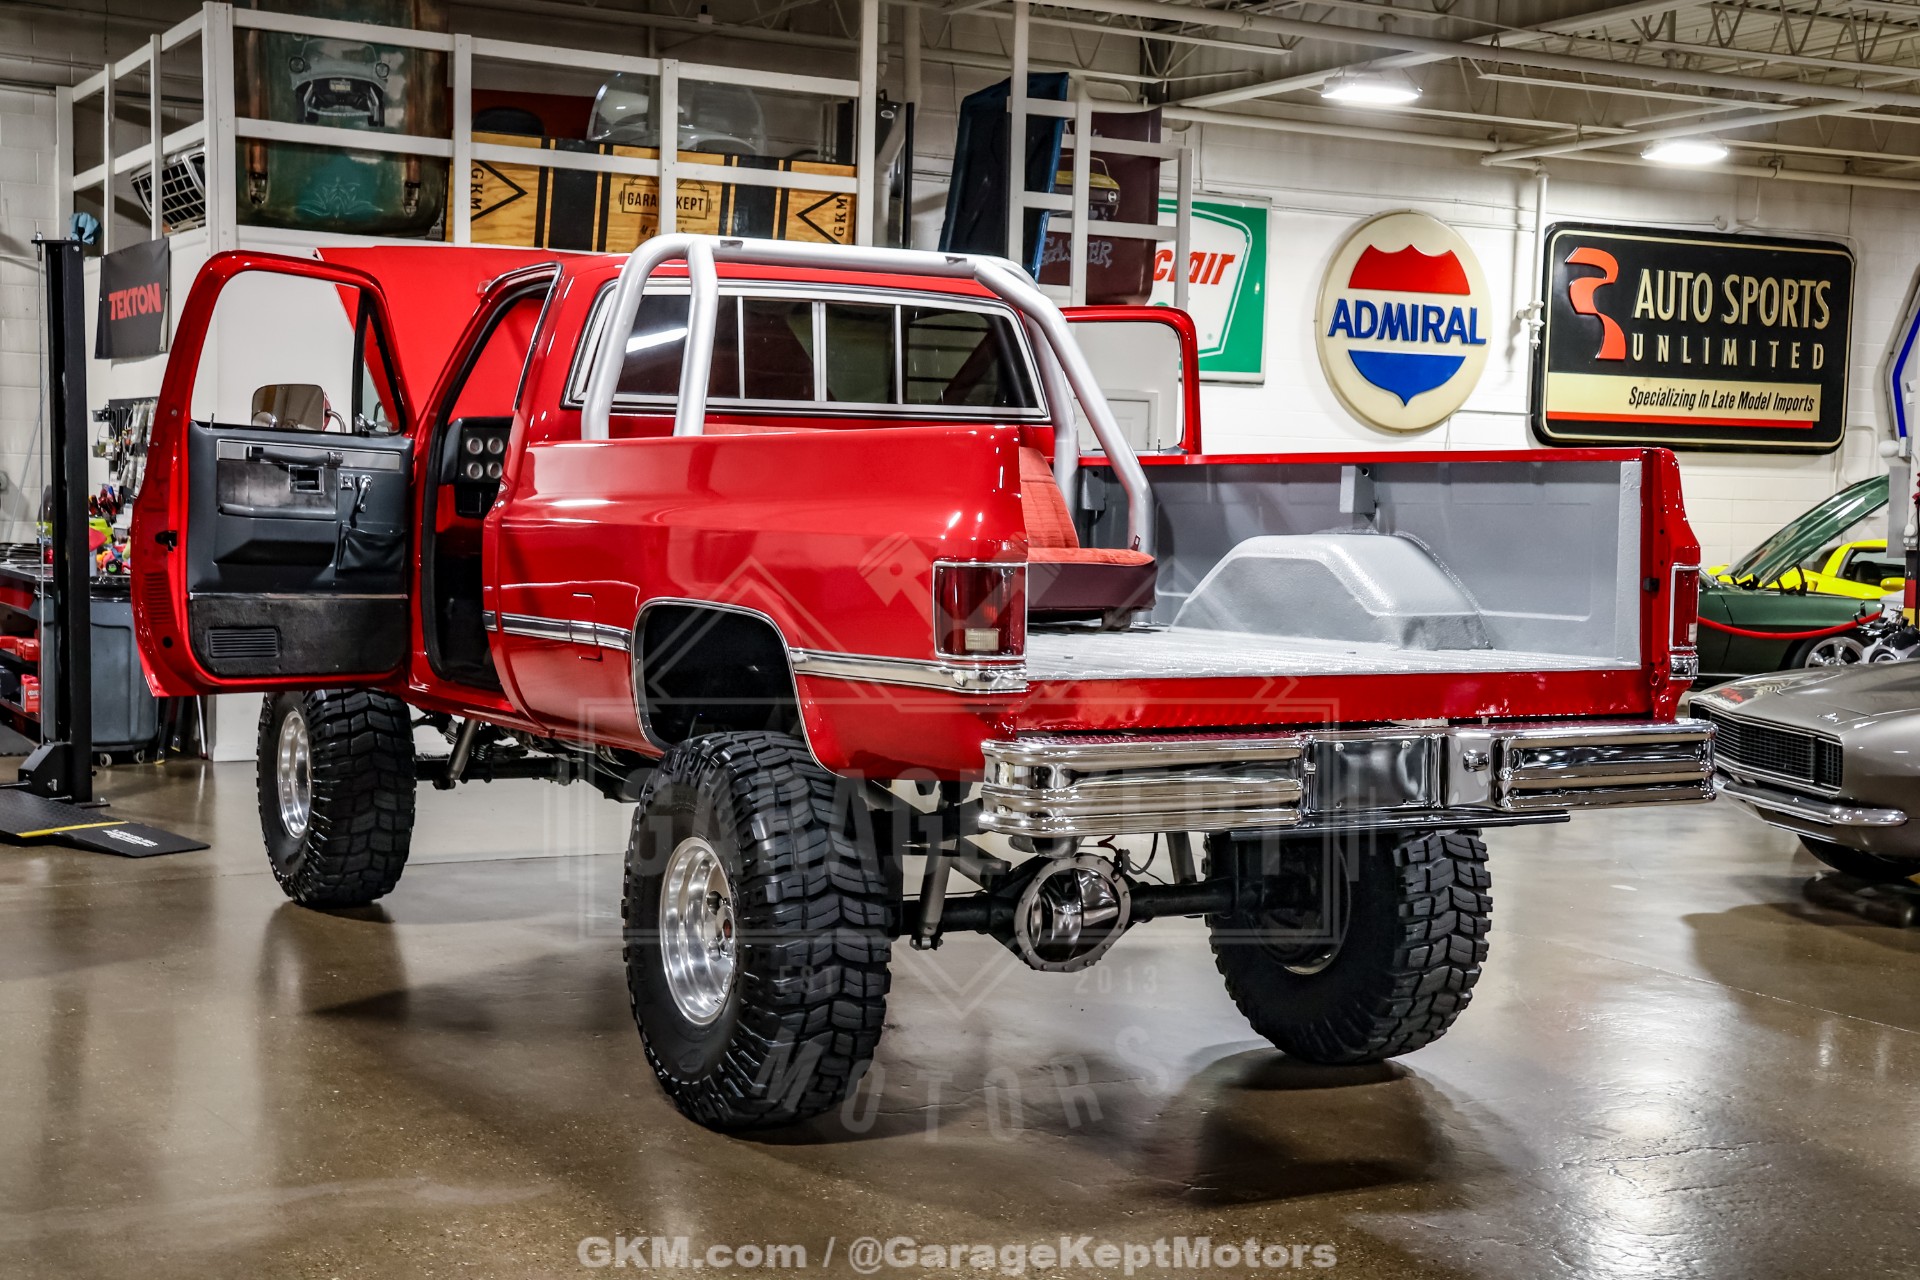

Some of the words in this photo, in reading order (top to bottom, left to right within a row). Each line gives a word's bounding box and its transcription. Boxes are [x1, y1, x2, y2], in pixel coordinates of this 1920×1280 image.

[470, 167, 484, 210] GKM
[627, 191, 658, 208] GARA
[833, 197, 848, 238] GKM
[108, 282, 162, 320] TEKTON
[1633, 268, 1714, 324] AUTO
[1720, 273, 1832, 330] SPORTS
[1327, 298, 1487, 345] ADMIRAL
[1632, 332, 1825, 371] UNLIMITED
[1628, 386, 1697, 411] Specializing
[1698, 389, 1710, 408] In
[1710, 390, 1736, 409] Late
[1737, 391, 1772, 410] Model
[1772, 392, 1815, 414] Imports
